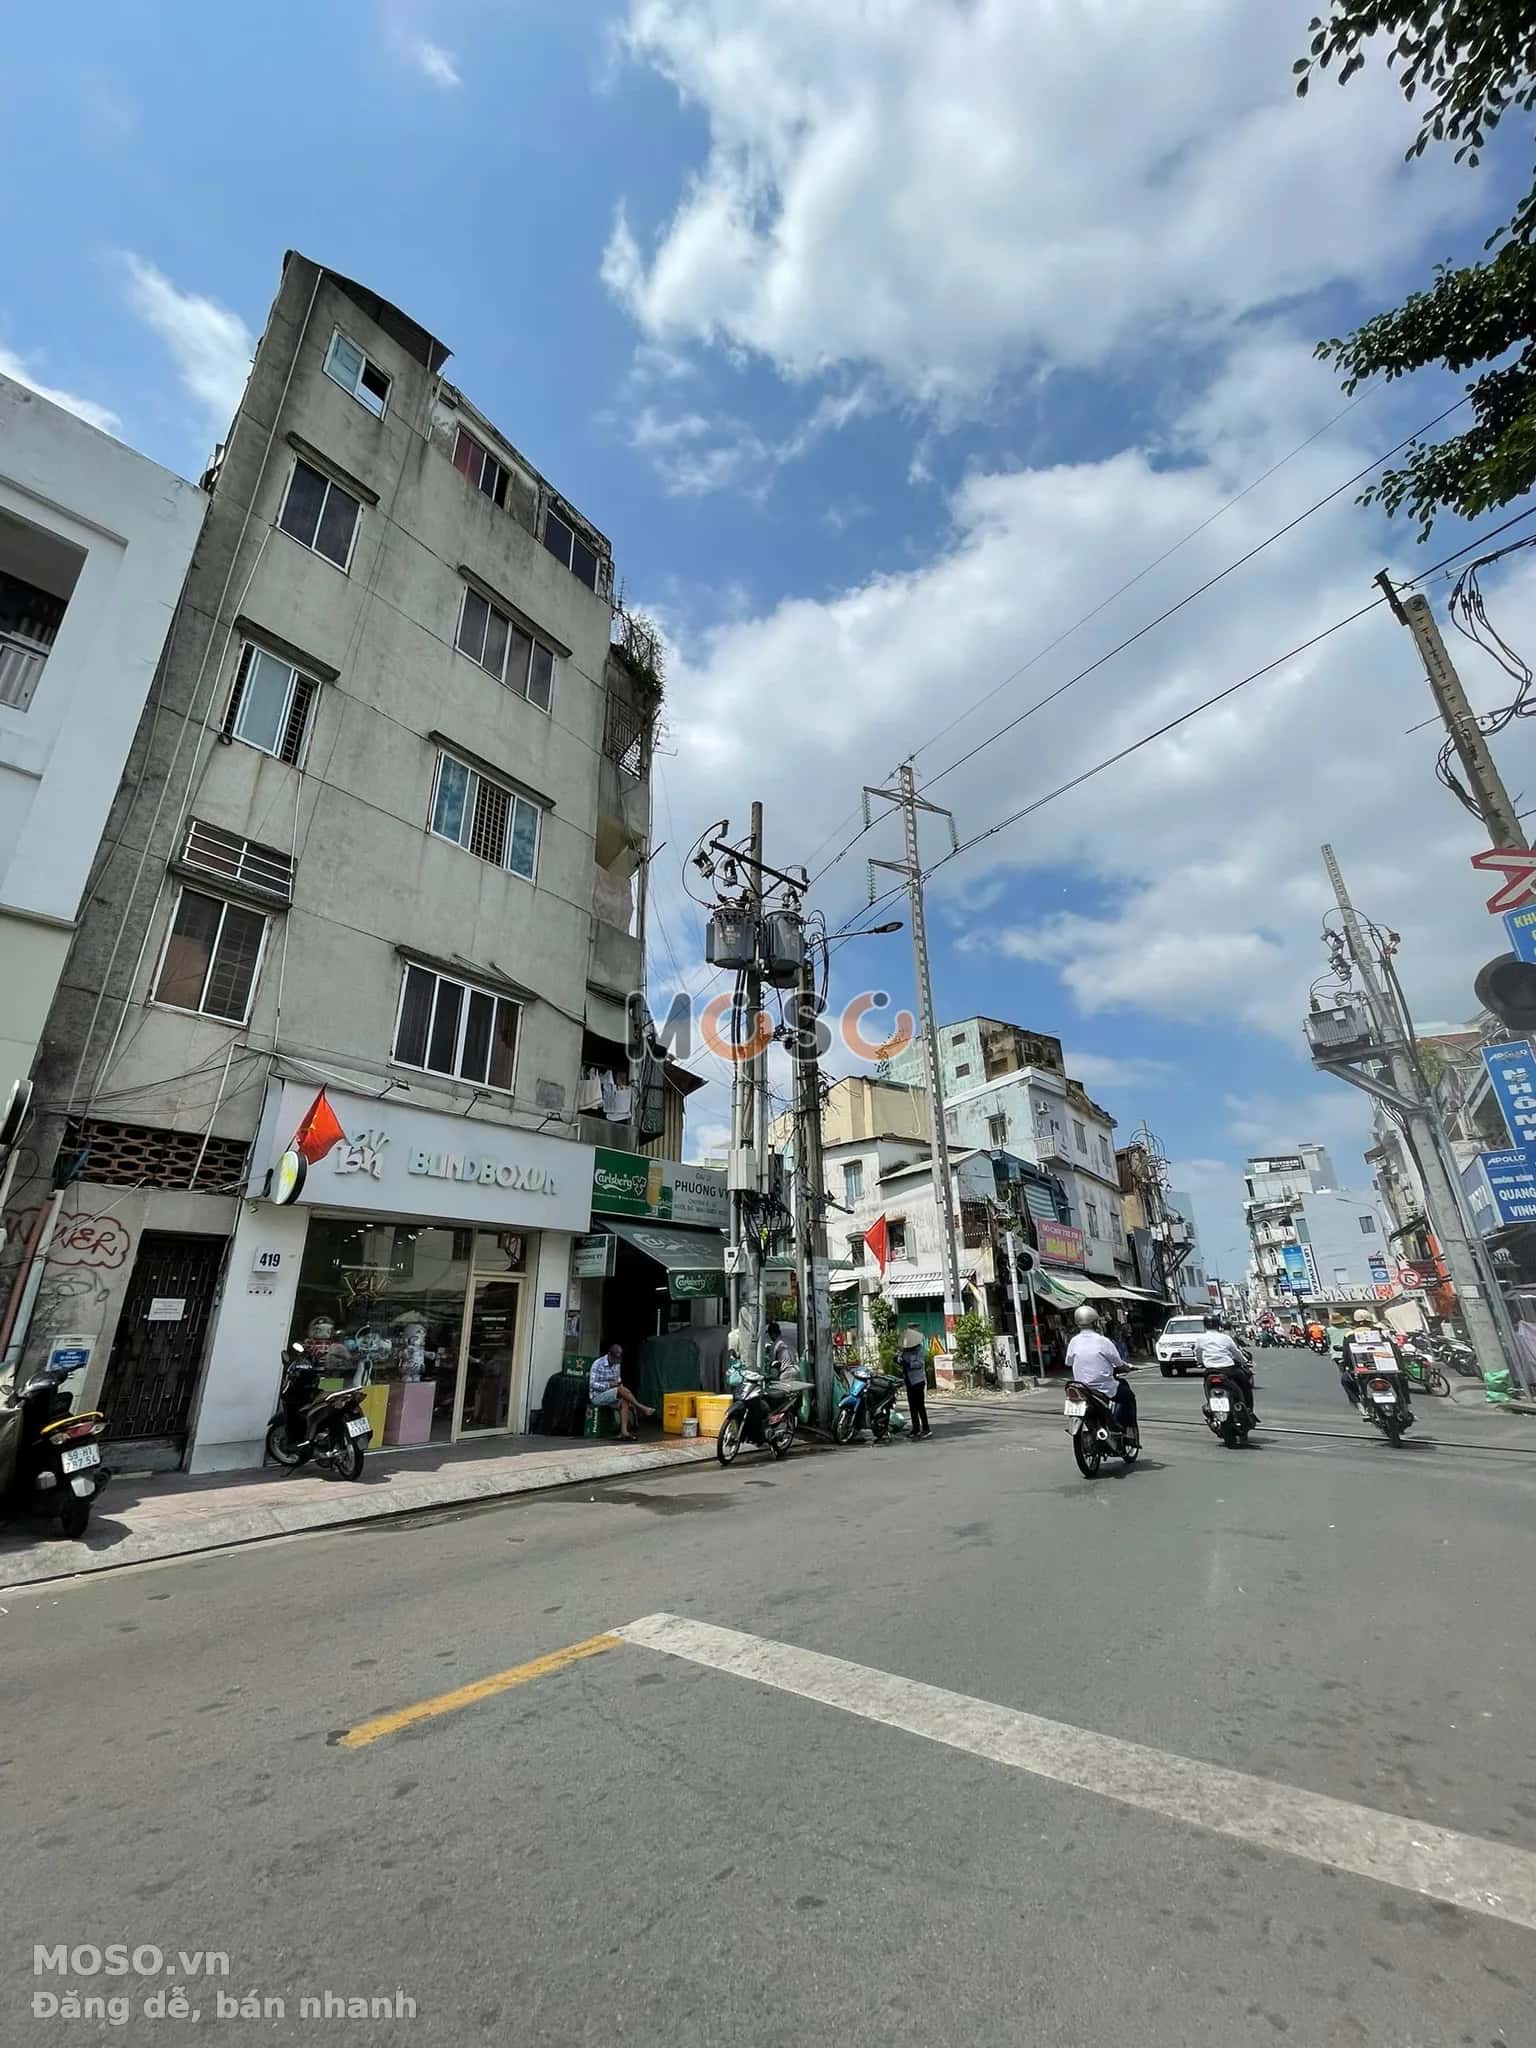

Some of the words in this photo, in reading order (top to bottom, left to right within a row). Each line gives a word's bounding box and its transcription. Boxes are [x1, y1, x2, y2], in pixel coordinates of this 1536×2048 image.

[1487, 1154, 1526, 1167] APOLLO
[594, 1168, 633, 1192] Carlsberg
[1499, 1188, 1536, 1202] QUANG
[1509, 1204, 1536, 1217] VINH
[259, 1252, 281, 1268] 419
[675, 1273, 706, 1291] Carlsberg
